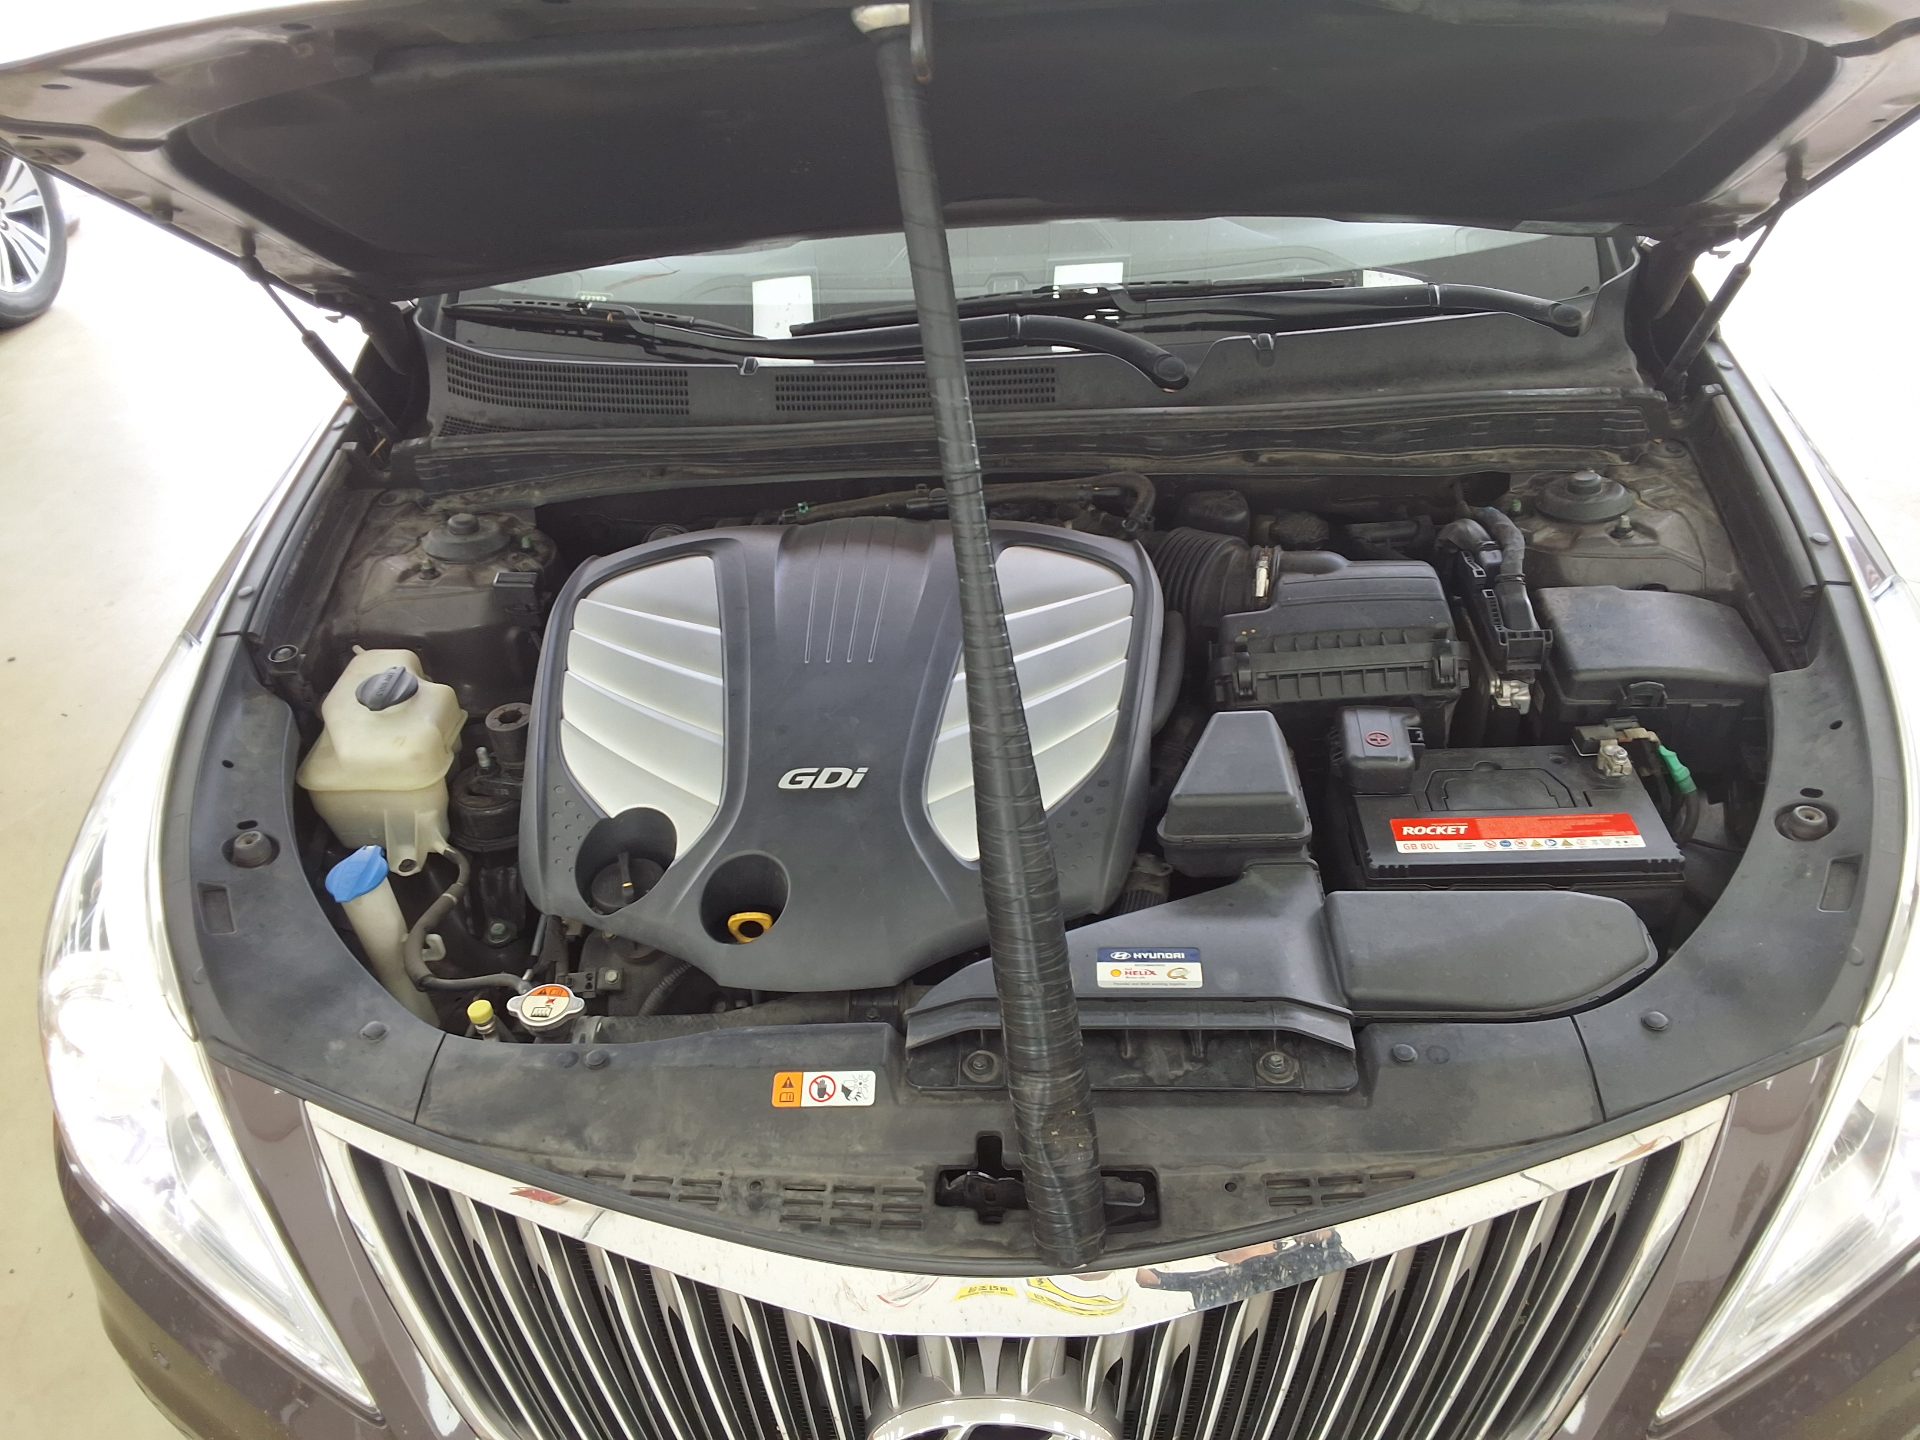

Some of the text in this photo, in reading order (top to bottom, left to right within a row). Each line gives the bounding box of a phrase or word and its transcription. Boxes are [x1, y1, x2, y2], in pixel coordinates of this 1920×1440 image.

[778, 767, 869, 789] GDi
[1402, 825, 1468, 836] ROCKET
[1124, 968, 1157, 976] HELIX
